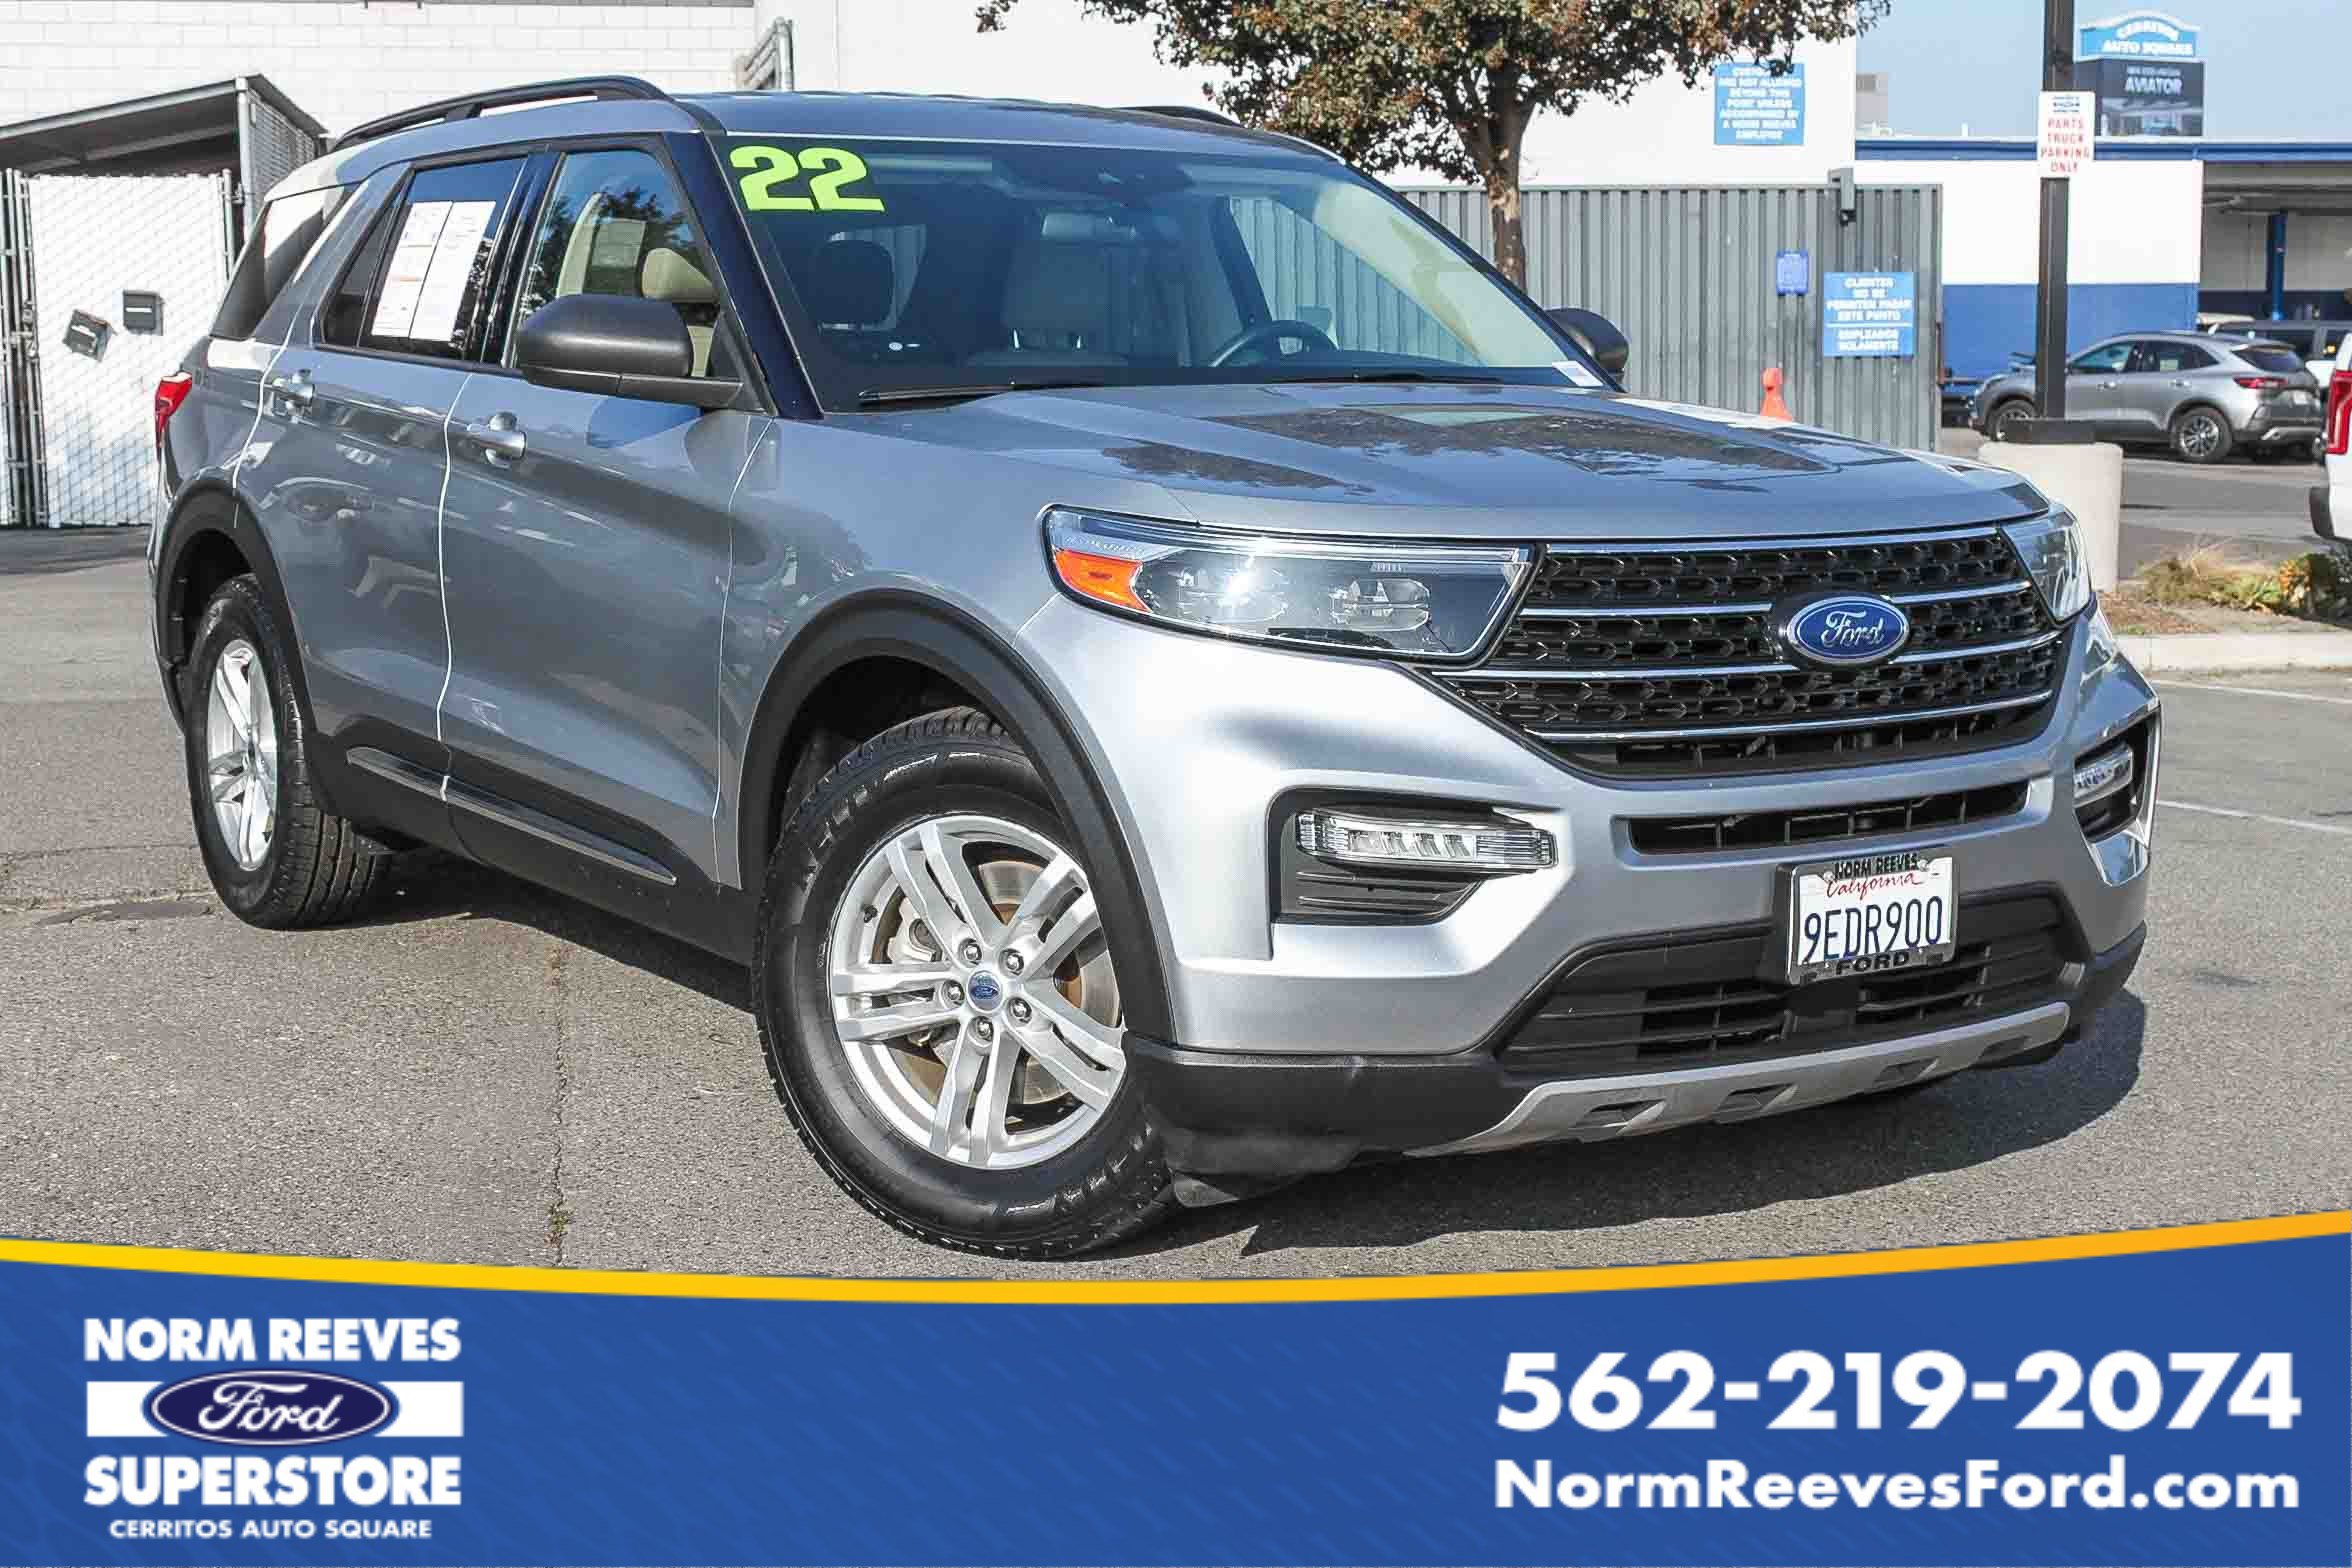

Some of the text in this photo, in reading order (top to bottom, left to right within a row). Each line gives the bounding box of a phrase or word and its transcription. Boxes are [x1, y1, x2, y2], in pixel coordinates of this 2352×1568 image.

[2101, 40, 2193, 56] AUTO SQUARE
[2125, 78, 2182, 97] AVIATOR
[2048, 118, 2084, 129] PARTS
[2048, 132, 2084, 144] TRUCK
[2041, 146, 2090, 159] PARKING
[2050, 161, 2079, 173] ONLY
[729, 145, 886, 213] 22
[1866, 311, 1901, 321] PUNTO
[1821, 610, 1885, 648] Ford
[1835, 853, 1919, 880] NORM REEVES
[1825, 872, 1925, 901] California
[1804, 895, 1943, 965] 9EDR900
[1836, 951, 1910, 975] FORD
